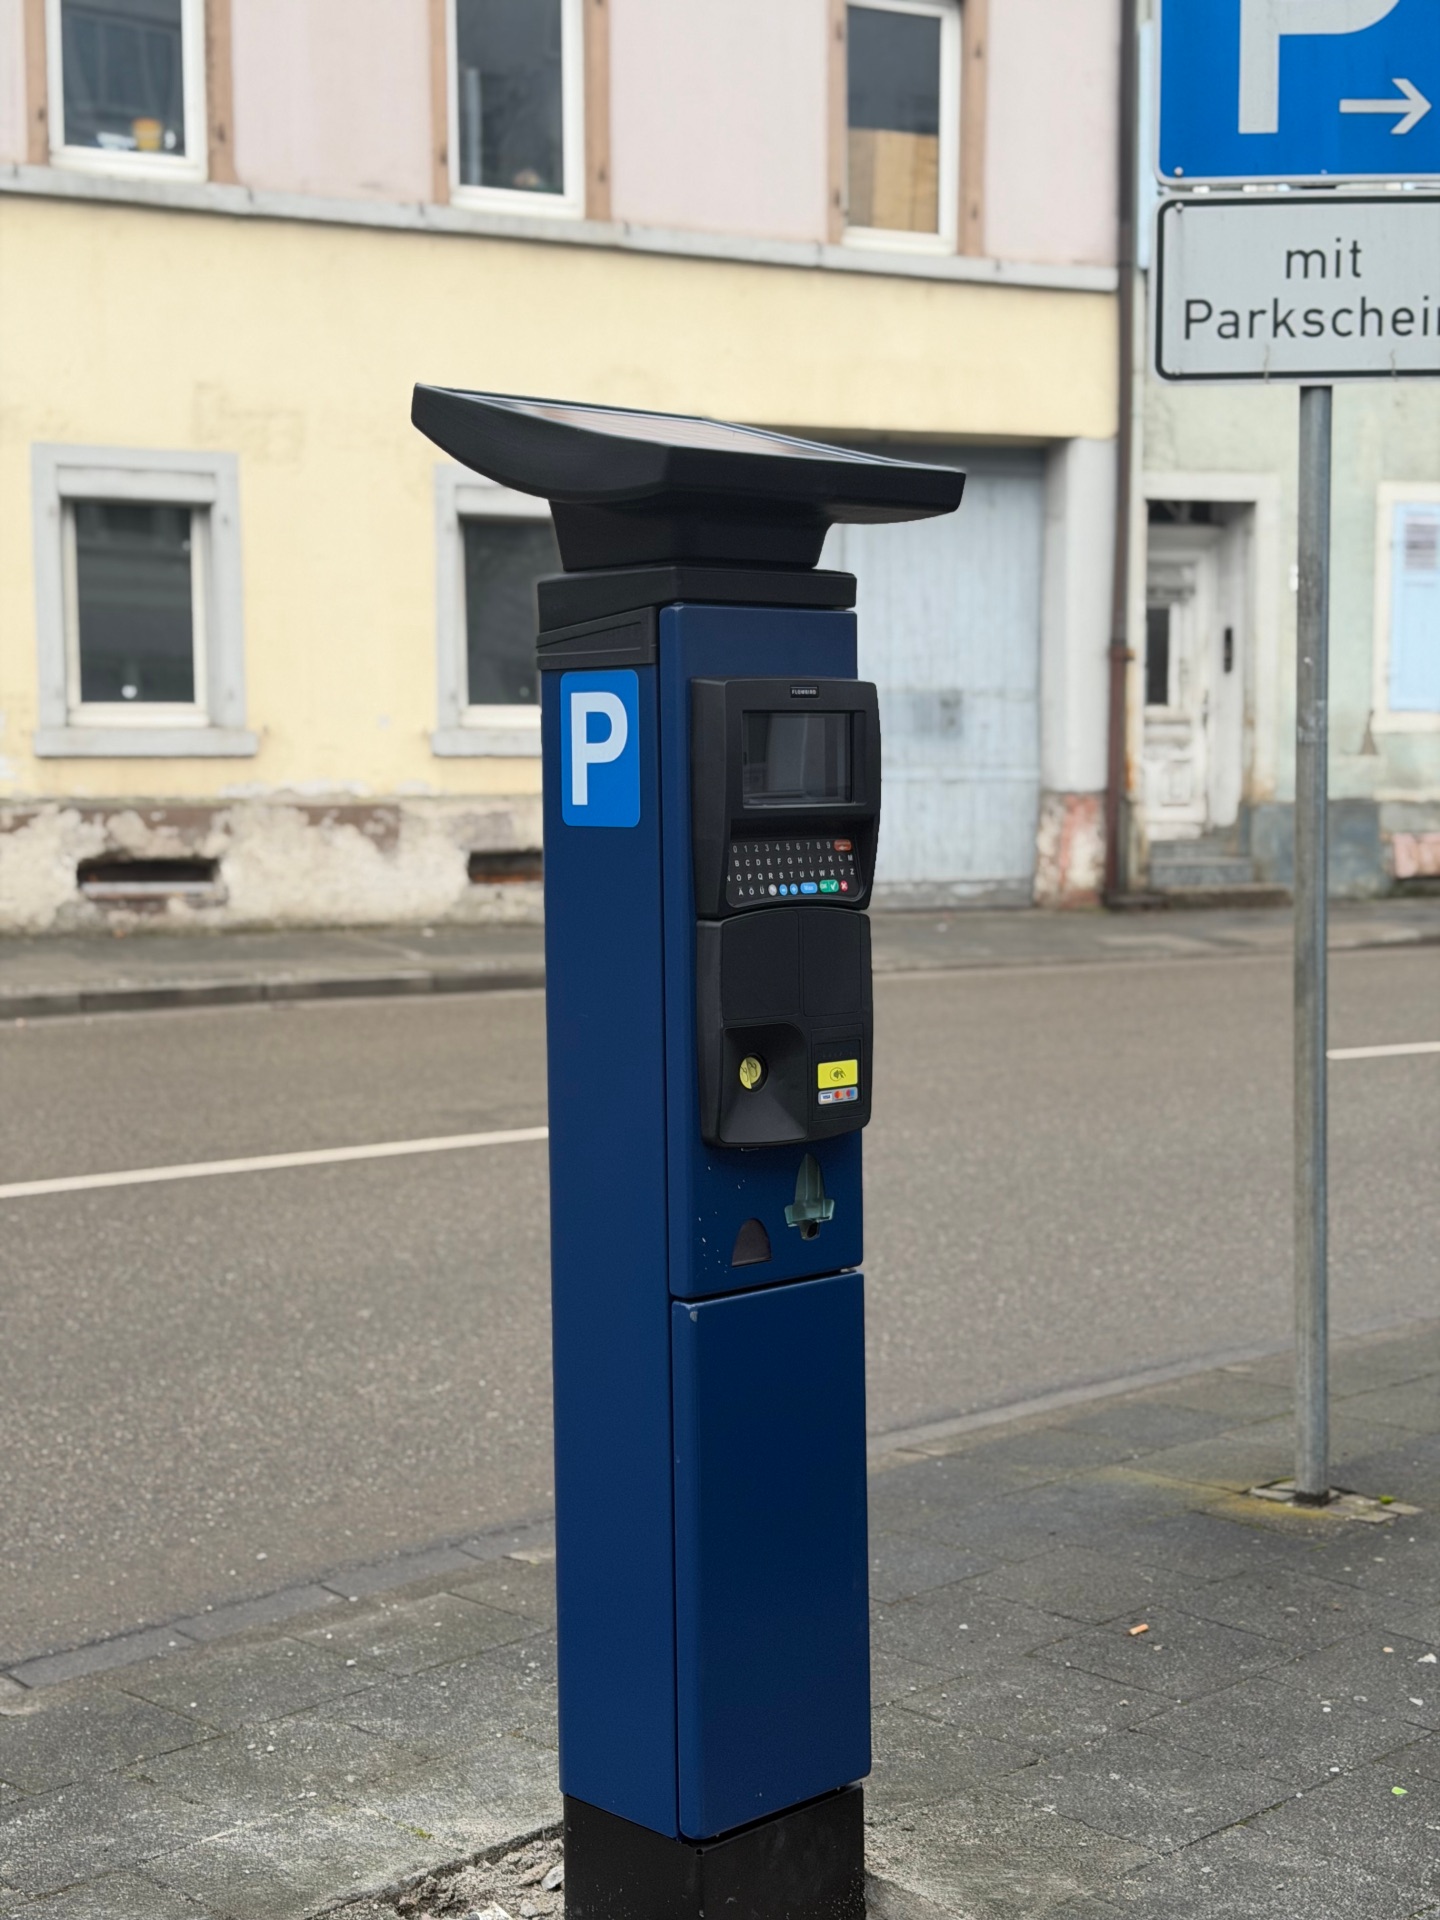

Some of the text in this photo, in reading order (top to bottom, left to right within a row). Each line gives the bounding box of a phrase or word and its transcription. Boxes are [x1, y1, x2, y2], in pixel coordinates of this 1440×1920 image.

[1286, 238, 1362, 279] mit
[1185, 295, 1440, 340] Parkschei
[571, 692, 628, 805] P
[733, 845, 738, 853] 0
[744, 845, 748, 853] 1
[754, 844, 759, 852] 2
[765, 844, 769, 852] 3
[786, 843, 790, 851] 5
[806, 842, 810, 850] 7
[826, 841, 831, 849] 9
